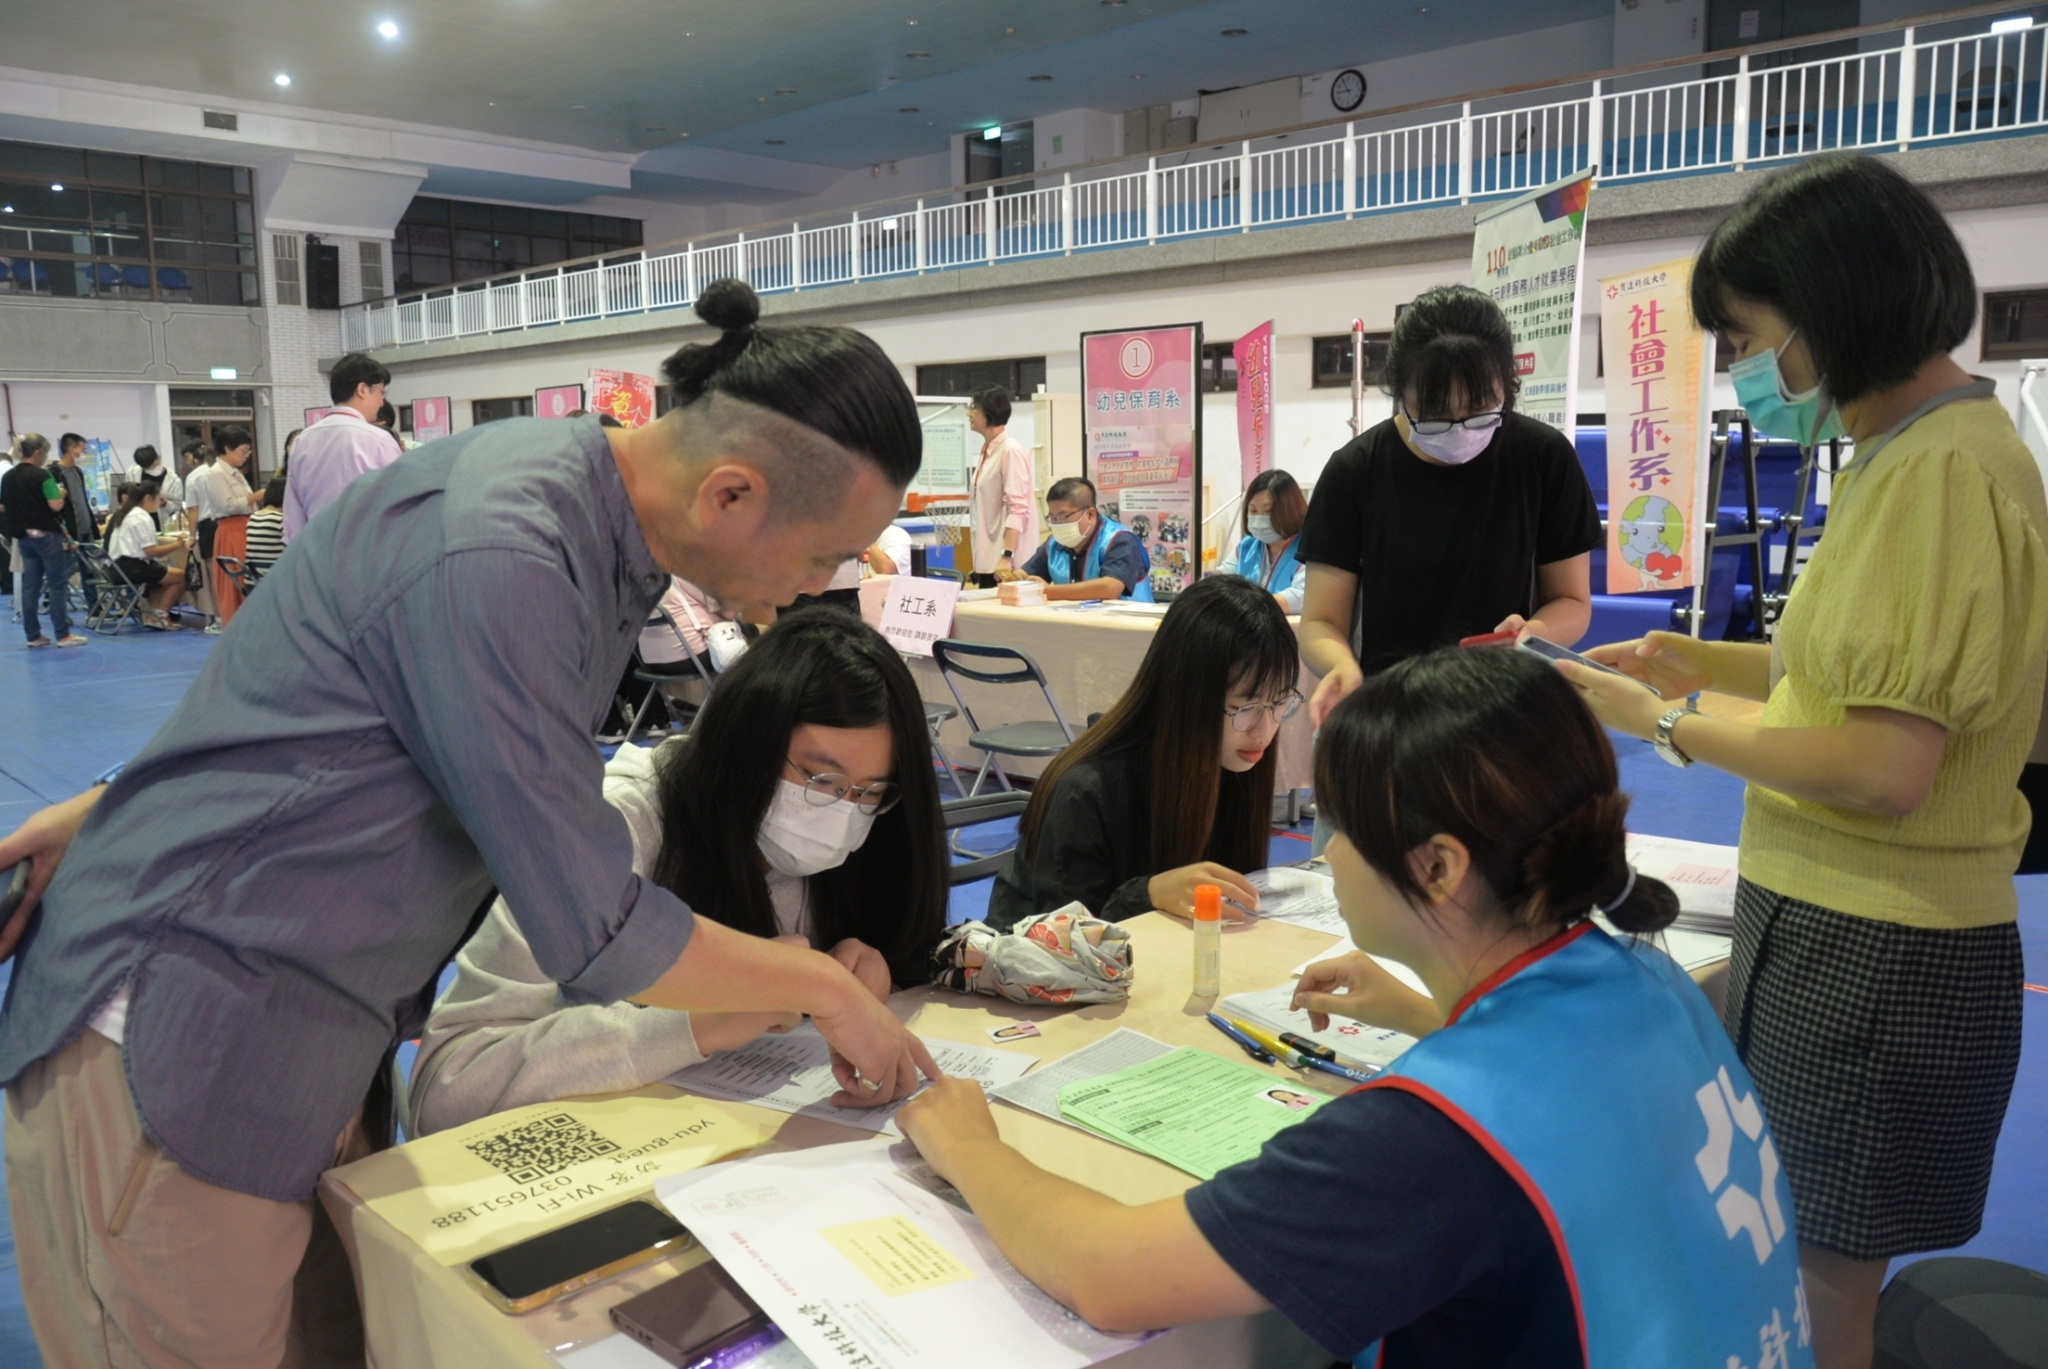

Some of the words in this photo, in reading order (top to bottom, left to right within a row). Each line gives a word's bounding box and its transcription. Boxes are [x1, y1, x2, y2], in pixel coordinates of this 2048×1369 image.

[1487, 246, 1507, 273] 110
[1096, 390, 1181, 412] 幼兒保育系
[1628, 299, 1672, 491] 社會工作系
[899, 595, 937, 618] 社工系
[607, 1118, 715, 1166] ydu-guest
[605, 1160, 663, 1188] 訪客
[431, 1175, 574, 1230] 037651188
[535, 1183, 605, 1214] Wi-Fi
[798, 1304, 880, 1369] 達科技大學
